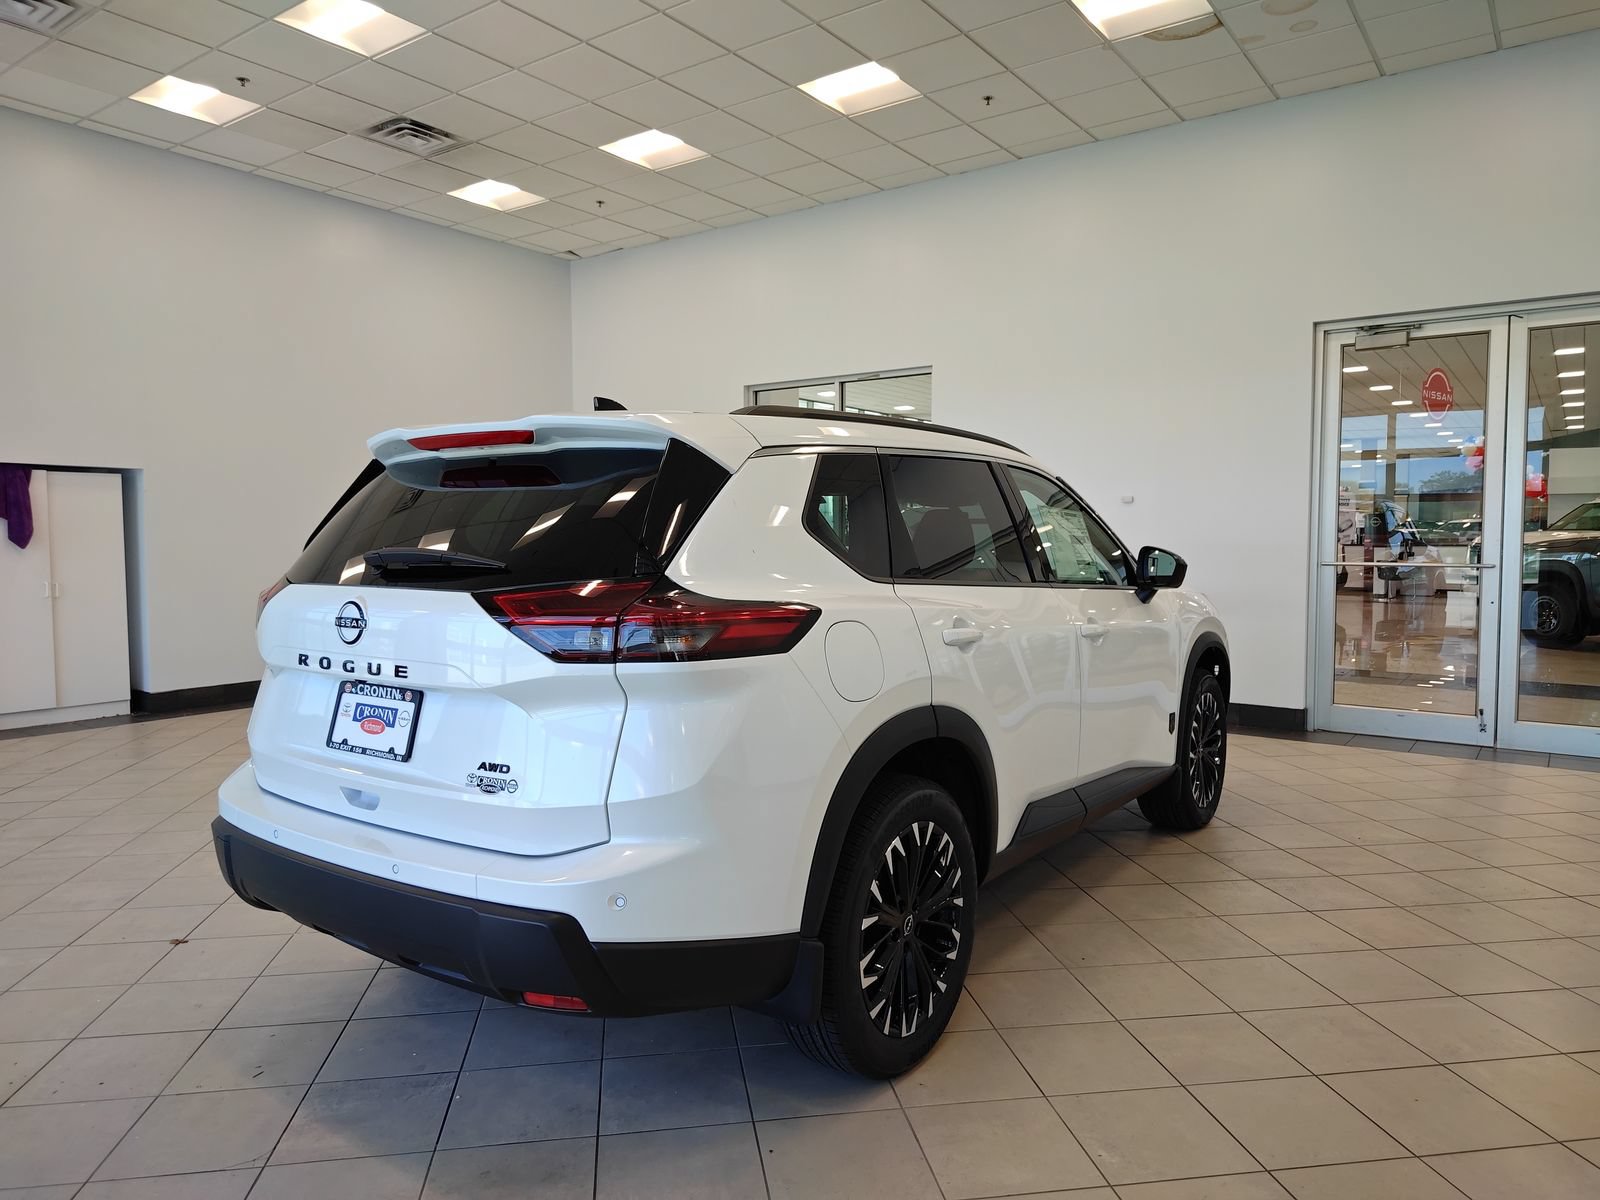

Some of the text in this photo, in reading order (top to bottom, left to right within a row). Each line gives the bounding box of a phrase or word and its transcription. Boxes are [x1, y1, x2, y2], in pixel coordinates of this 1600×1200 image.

[1423, 390, 1453, 402] NISSAN
[335, 618, 366, 628] NISSAN
[298, 653, 408, 678] ROGUE
[357, 684, 400, 699] CRONIN
[356, 705, 396, 725] CRONIN
[340, 744, 352, 752] EXIT
[477, 762, 510, 774] AWD
